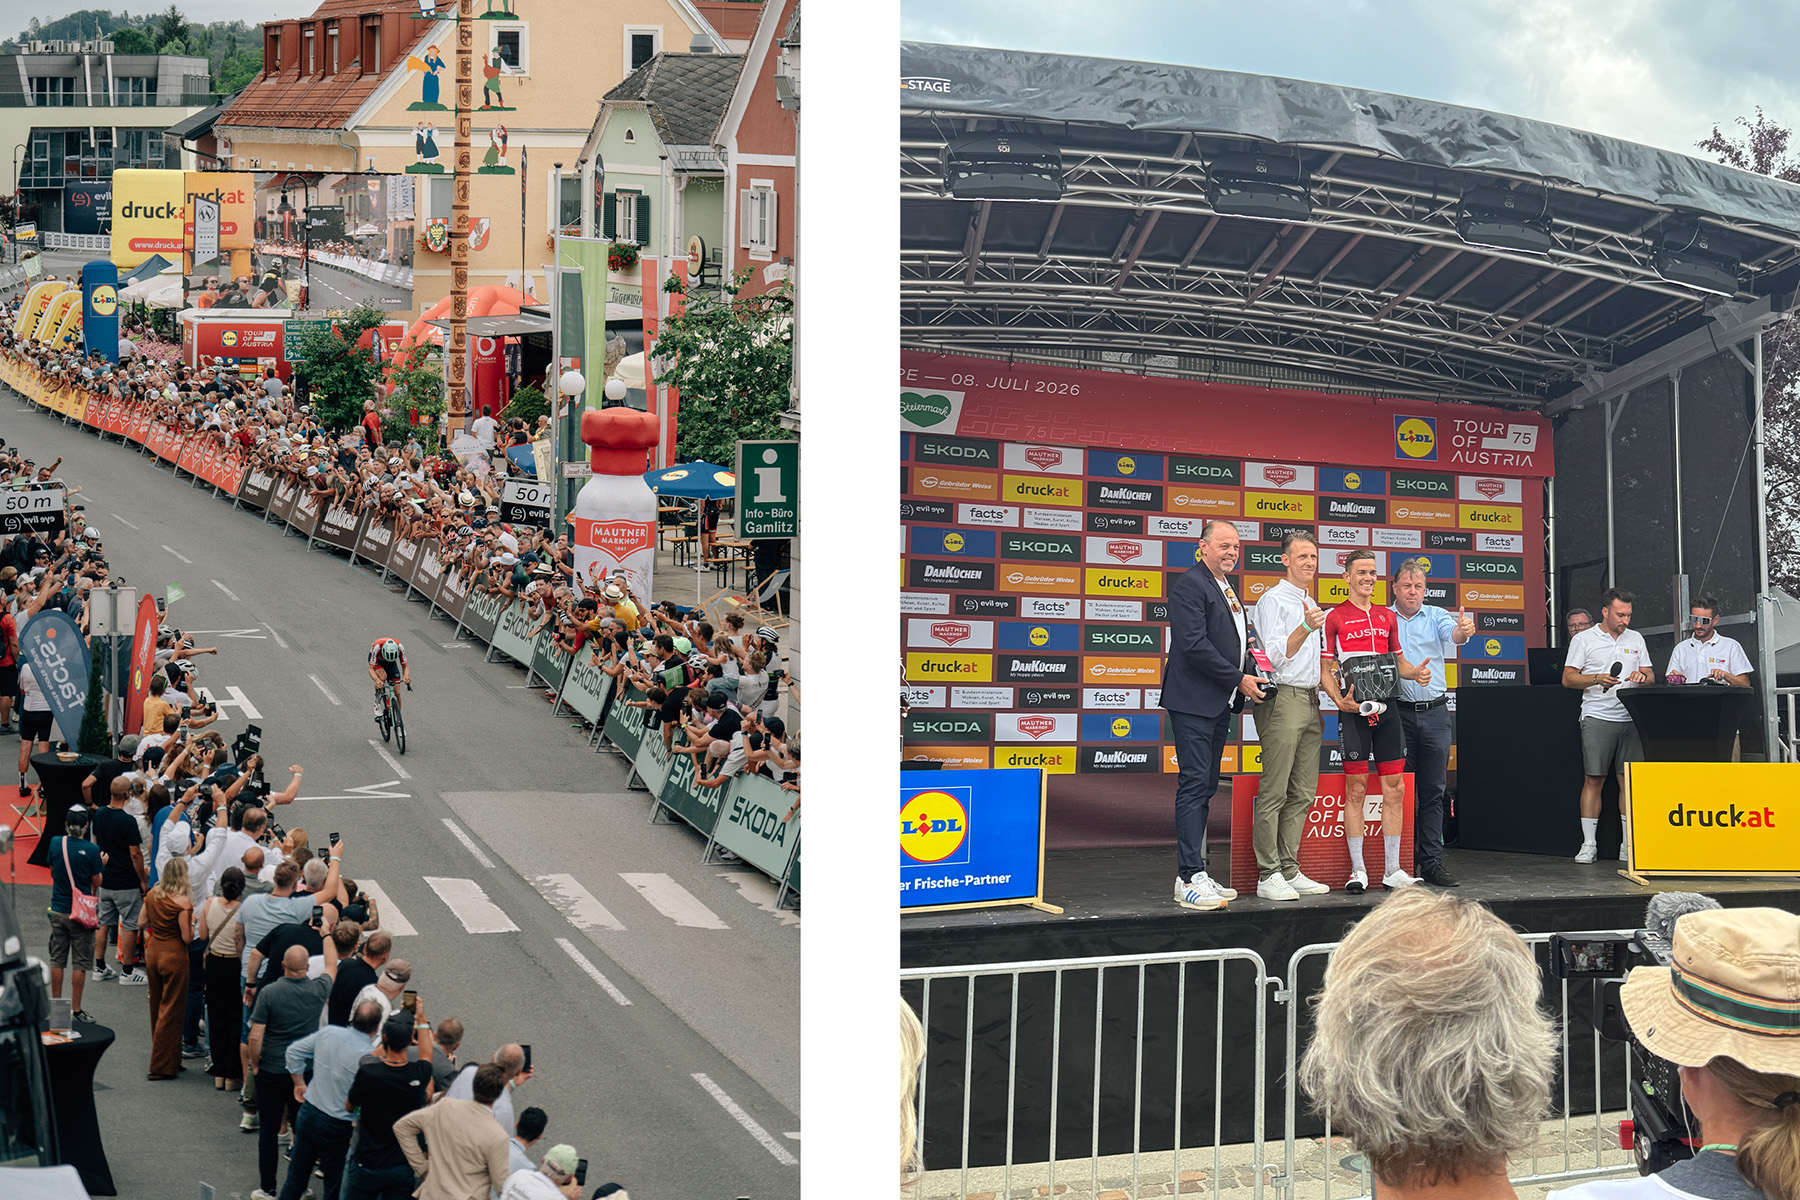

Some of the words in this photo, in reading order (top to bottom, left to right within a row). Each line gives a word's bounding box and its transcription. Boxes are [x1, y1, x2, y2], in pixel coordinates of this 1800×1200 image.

[908, 79, 951, 93] STAGE
[94, 192, 112, 200] evil
[93, 294, 116, 304] LIDL
[951, 373, 980, 386] 08.
[986, 376, 1030, 391] JULI
[1034, 380, 1081, 396] 2026
[900, 401, 951, 418] Steiermark
[1453, 419, 1505, 435] TOUR
[1399, 430, 1433, 444] LIDL
[1452, 435, 1478, 448] OF
[1512, 431, 1532, 445] 75
[1451, 450, 1533, 467] AUSTRIA
[516, 487, 539, 501] 50
[1017, 482, 1069, 497] druck.at
[6, 496, 29, 510] 50
[34, 496, 51, 508] m
[1256, 499, 1303, 512] druck.at
[528, 509, 544, 518] evil
[745, 508, 793, 519] Info-Büro
[970, 508, 1004, 519] facts
[1470, 511, 1512, 523] druck.at
[594, 527, 646, 537] MAUTNER
[745, 520, 793, 534] Gamlitz
[1158, 520, 1189, 531] facts
[1328, 528, 1356, 539] facts
[601, 537, 639, 545] MARKHOF
[1485, 536, 1511, 547] facts
[1098, 575, 1149, 589] druck.at
[1032, 601, 1065, 611] facts
[921, 660, 978, 673] druck.at
[1094, 692, 1126, 702] facts
[1008, 753, 1062, 765] druck.at
[1308, 811, 1334, 823] OF
[1667, 803, 1776, 829] druck.at
[902, 813, 962, 837] LIDL
[914, 874, 1011, 890] Frische-Partner
